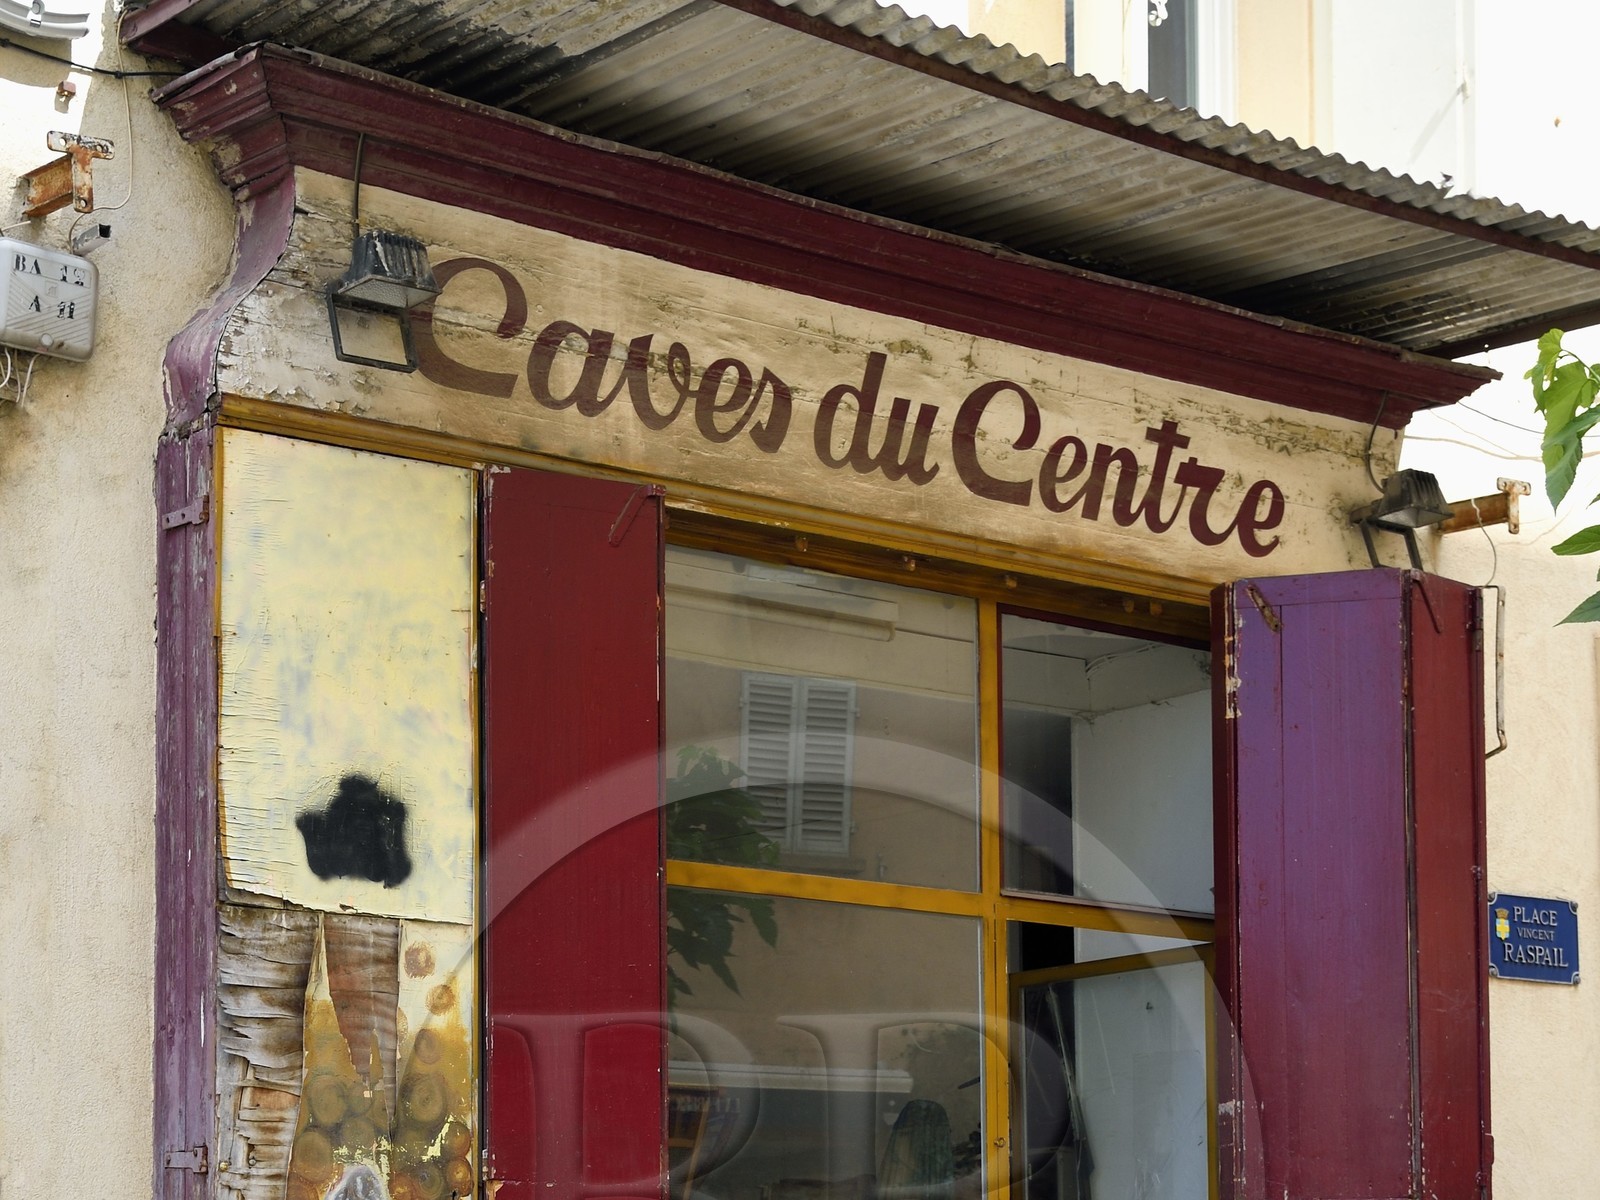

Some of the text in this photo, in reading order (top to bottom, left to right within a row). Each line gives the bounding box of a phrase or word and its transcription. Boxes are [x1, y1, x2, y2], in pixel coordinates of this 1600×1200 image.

[28, 295, 42, 313] A
[409, 256, 1286, 558] Caves du Centre
[1513, 906, 1558, 926] PLACE
[1517, 927, 1555, 941] VINCENT
[1504, 943, 1569, 967] RASPAIL
